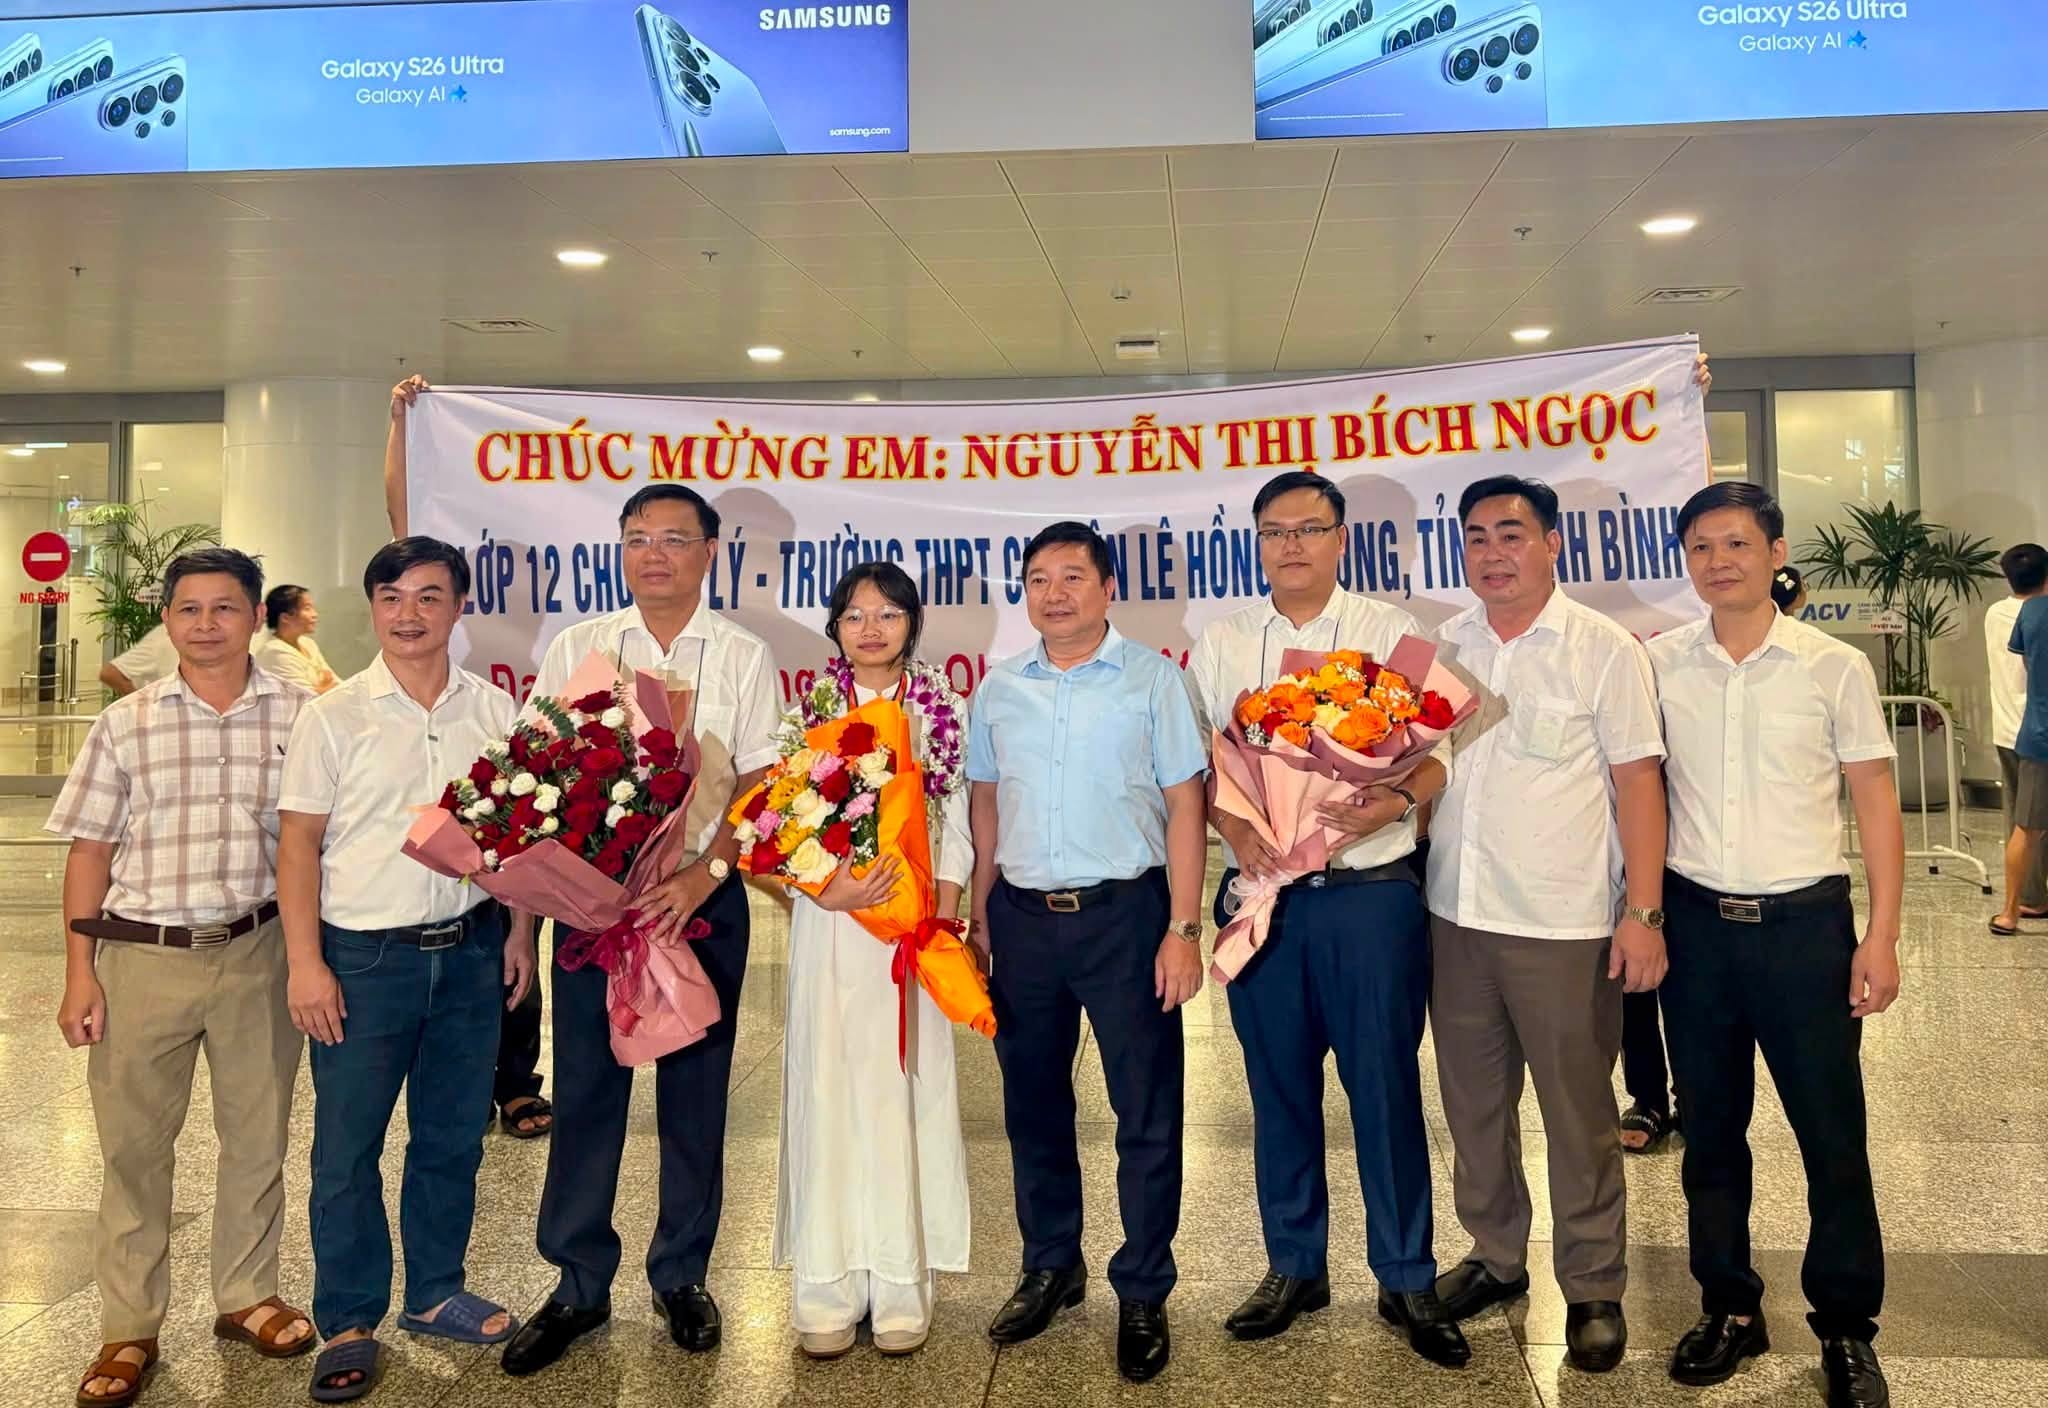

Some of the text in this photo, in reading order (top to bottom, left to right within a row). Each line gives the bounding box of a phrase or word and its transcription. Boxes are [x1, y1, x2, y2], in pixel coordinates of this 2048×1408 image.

[760, 4, 891, 30] SAMSUNG
[1698, 0, 1908, 27] Galaxy S26 Ultra
[1739, 32, 1842, 54] Galaxy AI
[321, 55, 504, 81] Galaxy S26 Ultra
[355, 86, 446, 107] Galaxy AI
[829, 126, 891, 137] samsung.com
[476, 388, 1658, 483] CHÚC MỪNG EM: NGUYỄN THỊ BÍCH NGỌC
[1139, 516, 1176, 601] LÊ
[1417, 491, 1471, 590] TỈN
[1598, 492, 1684, 582] BÌNH
[526, 544, 562, 614] 12
[708, 526, 746, 610] LÝ
[915, 535, 991, 606] THPT
[19, 591, 35, 604] NO
[1800, 602, 1852, 621] ACV
